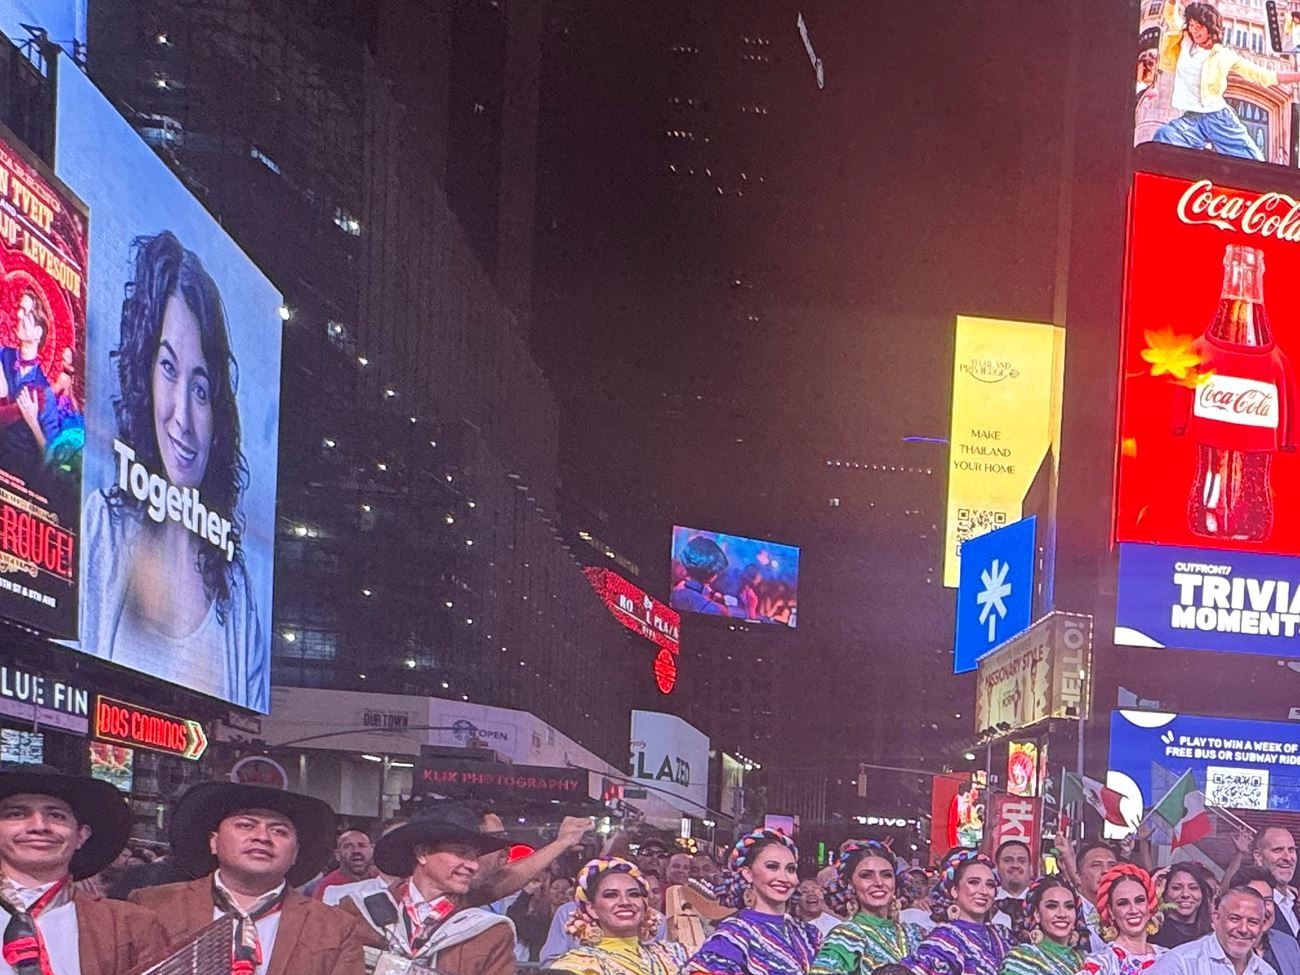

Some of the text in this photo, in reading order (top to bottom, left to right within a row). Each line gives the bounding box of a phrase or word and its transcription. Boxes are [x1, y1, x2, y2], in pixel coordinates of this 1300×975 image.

[11, 176, 54, 234] TVEIT
[23, 230, 81, 298] LEVESQUE
[1200, 382, 1273, 417] Coca-Cola
[971, 429, 1000, 440] MAKE
[960, 444, 1012, 457] THAILAND
[954, 459, 1015, 475] YOUR HOME
[114, 439, 235, 560] Together,
[3, 503, 74, 578] ROUGE!
[1021, 643, 1043, 672] STYLE
[1061, 620, 1084, 716] HELLO!
[54, 683, 88, 715] FIN
[100, 703, 187, 751] DOS CAMINOS
[363, 712, 408, 727] OUR TOWN
[479, 729, 508, 741] OPEN
[1179, 736, 1299, 754] PLAY TO WIN A WEEK OF
[1165, 746, 1193, 758] FREE
[1194, 749, 1217, 760] BUS
[1218, 750, 1233, 761] OR
[1234, 751, 1278, 764] SUBWAY
[423, 767, 579, 792] KLIK PHOTOGRAPHY
